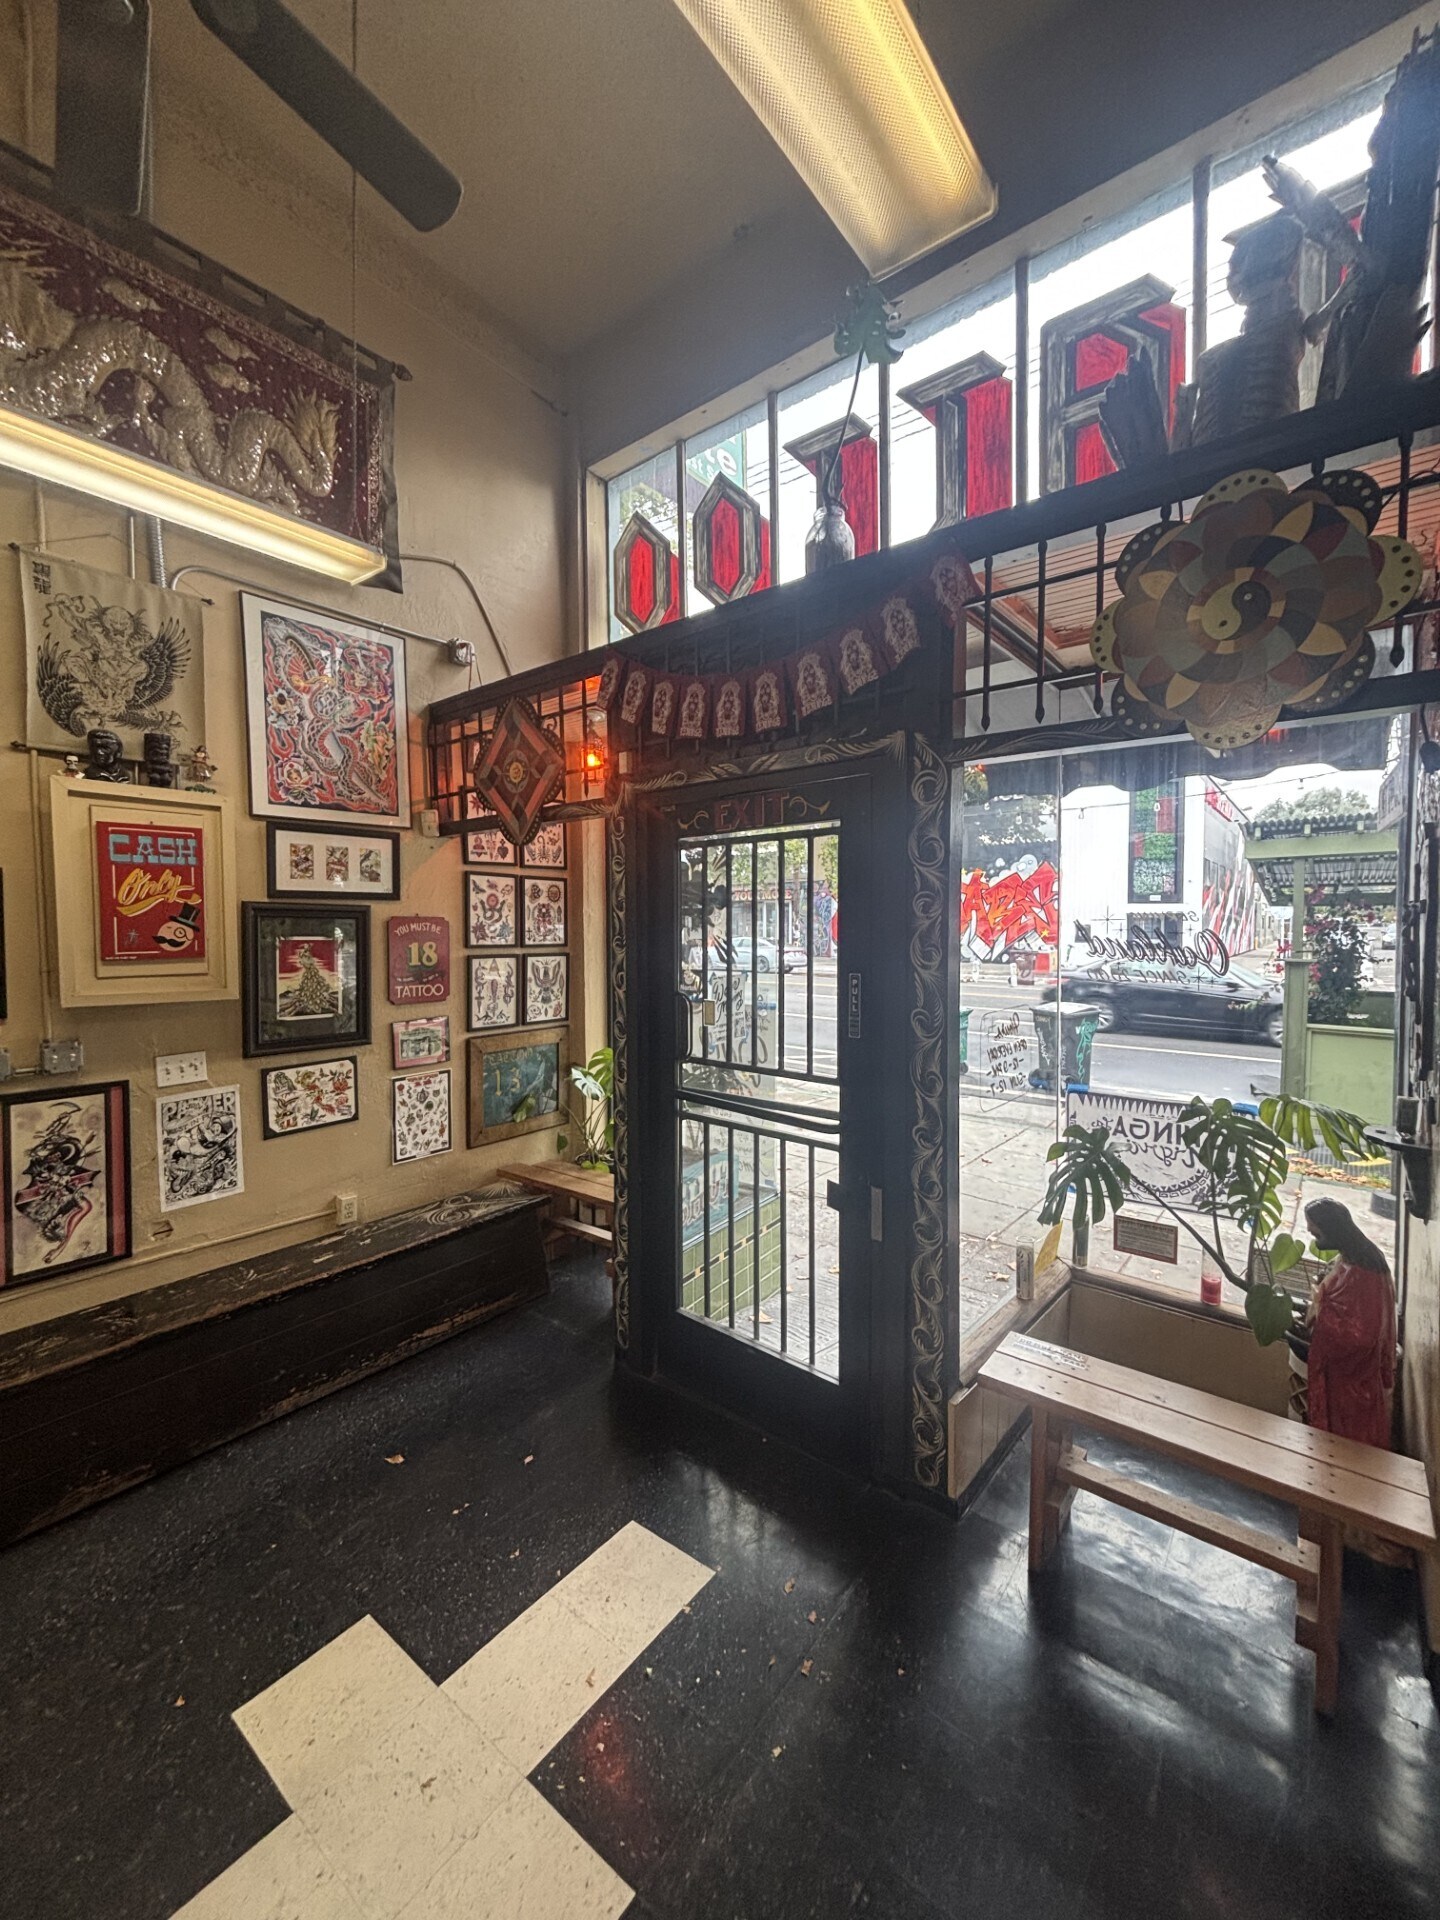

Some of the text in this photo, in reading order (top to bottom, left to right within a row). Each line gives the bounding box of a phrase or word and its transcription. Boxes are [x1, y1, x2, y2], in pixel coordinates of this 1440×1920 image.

[714, 792, 790, 832] EXIT
[108, 833, 198, 866] CASH
[117, 867, 199, 910] Only
[761, 887, 793, 900] MOE
[394, 922, 442, 937] YOU MUST BE
[408, 941, 439, 967] 18
[394, 983, 445, 999] TATTOO
[851, 979, 859, 1012] PULL
